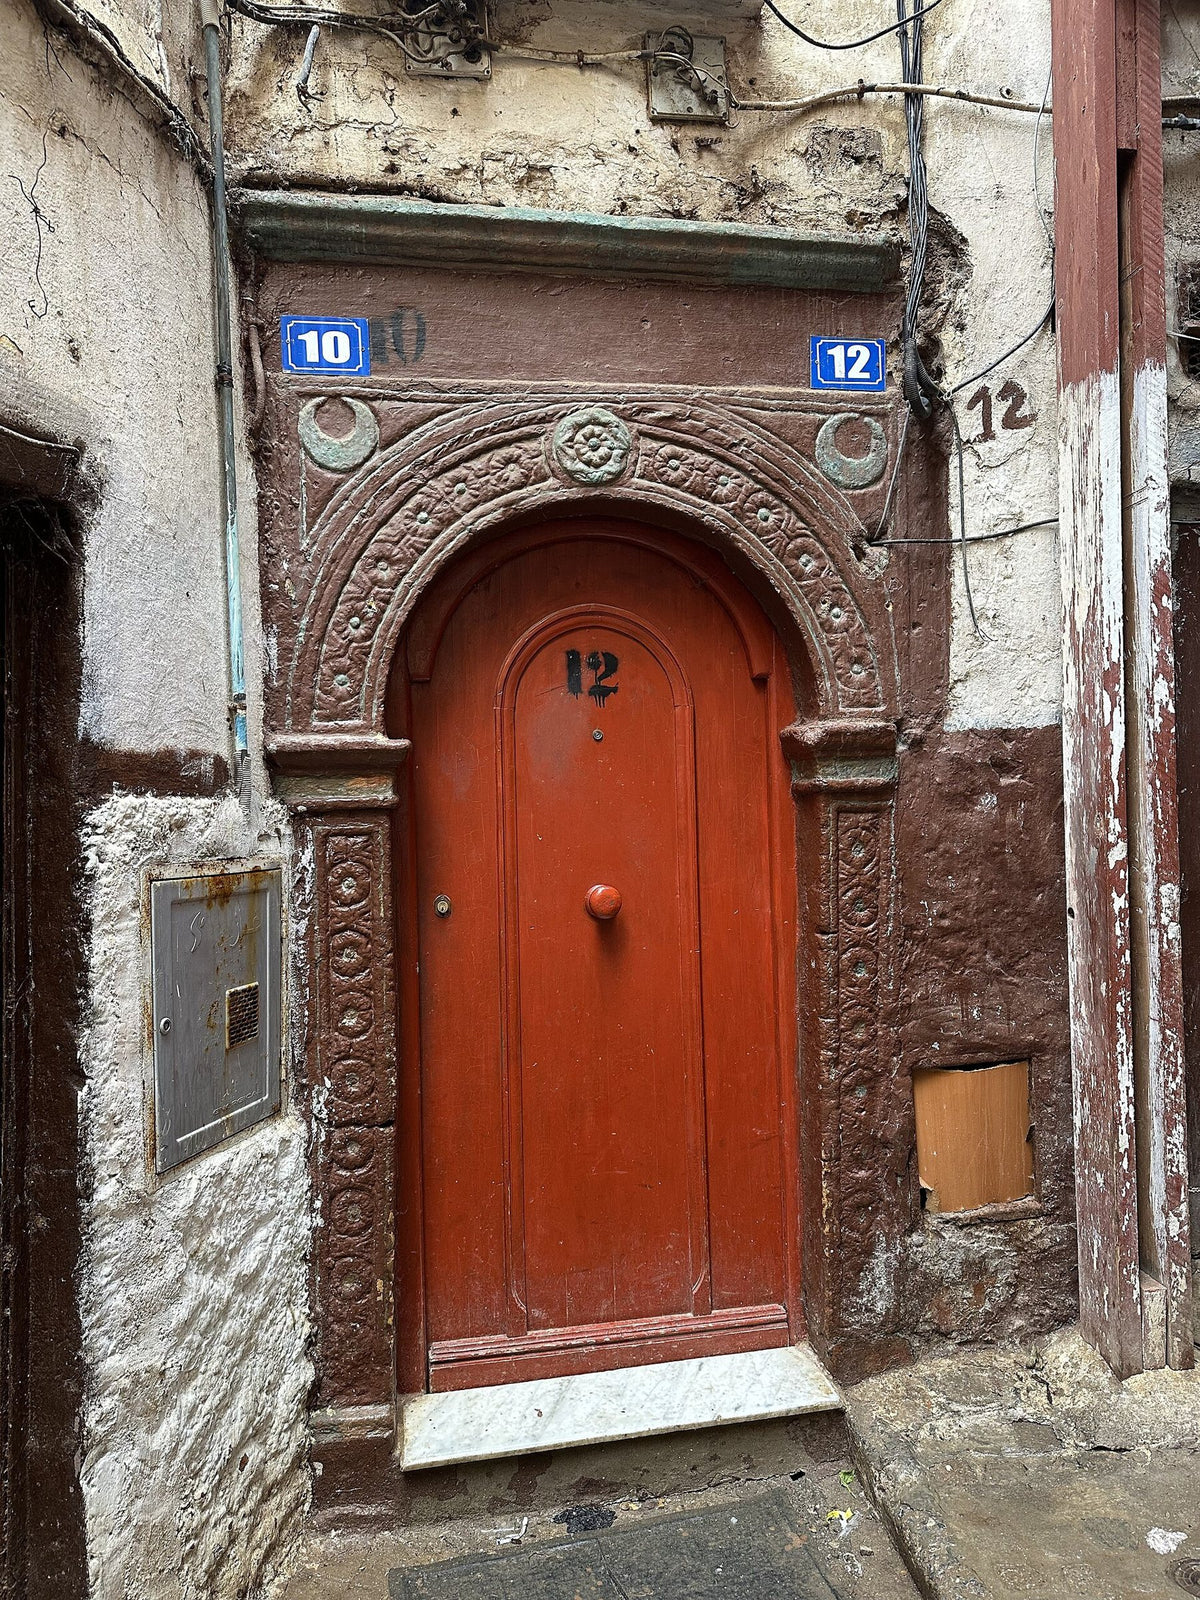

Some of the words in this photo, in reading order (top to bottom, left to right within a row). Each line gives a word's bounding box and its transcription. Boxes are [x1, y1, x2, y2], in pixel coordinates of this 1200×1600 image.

[297, 329, 351, 364] 10
[826, 344, 872, 380] 12
[966, 379, 1037, 443] 12
[565, 648, 619, 701] 12
